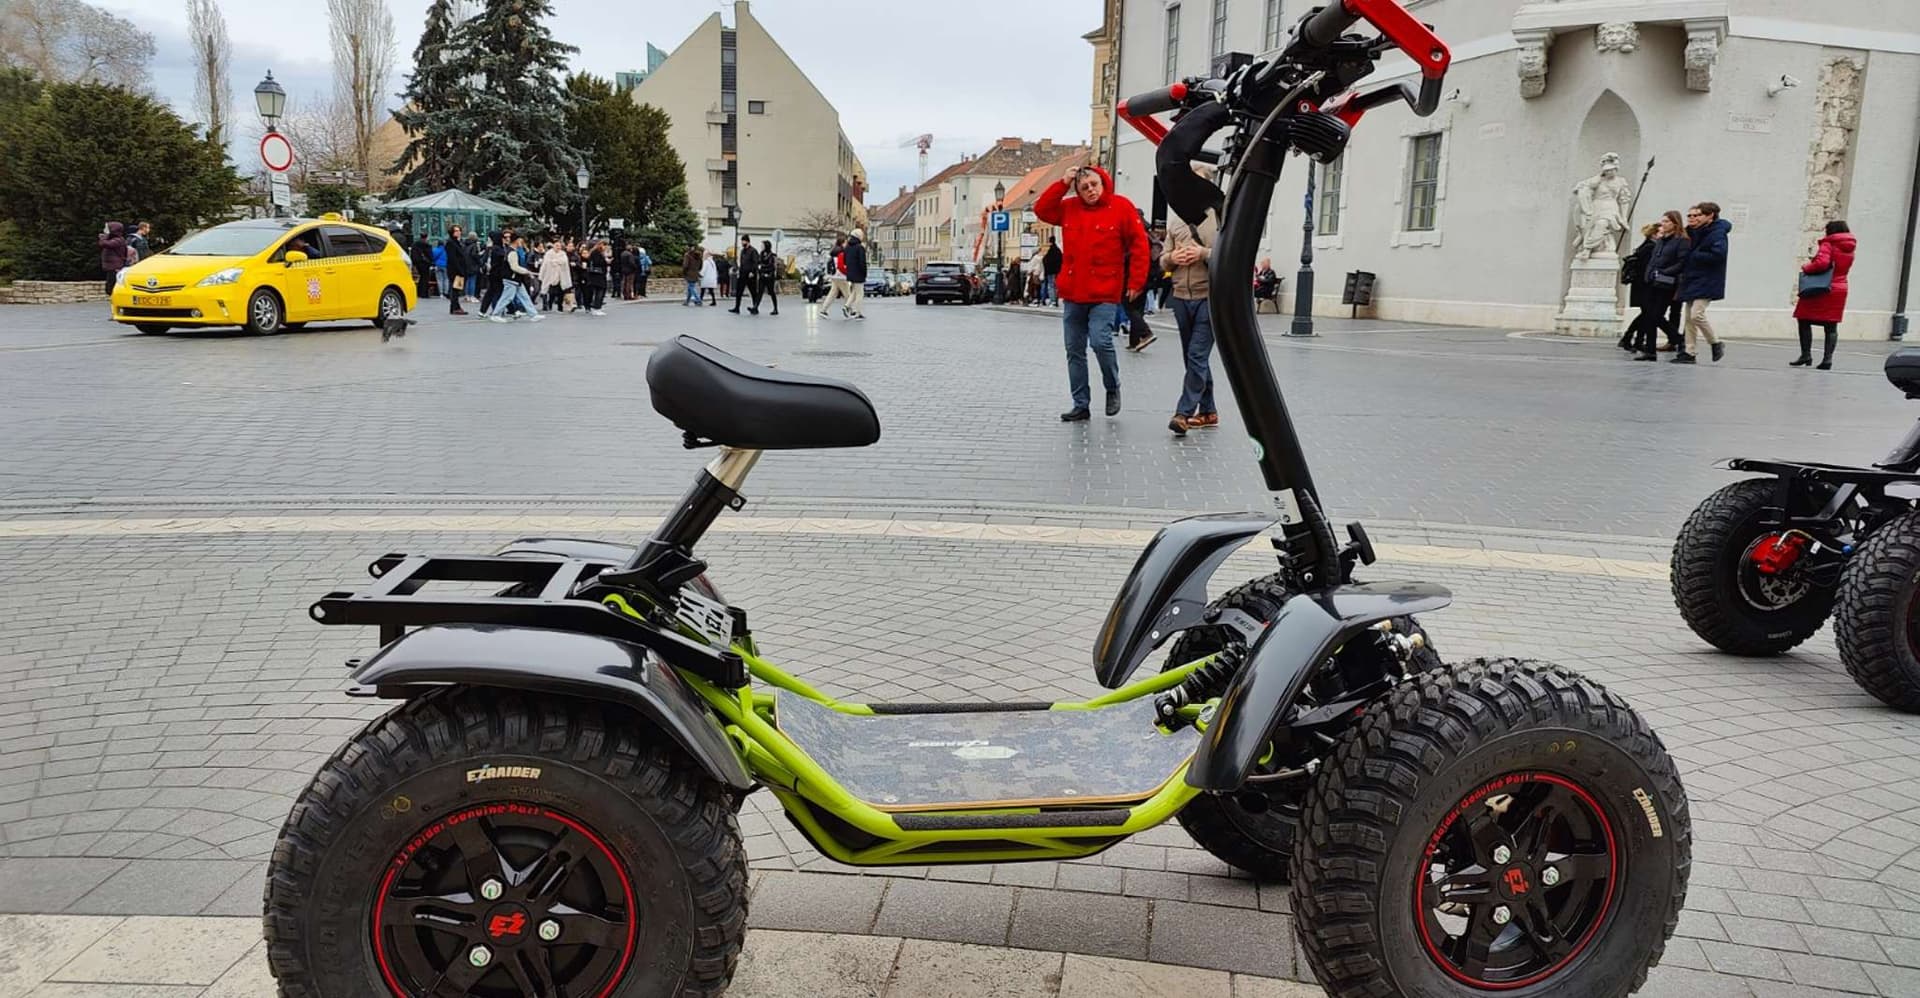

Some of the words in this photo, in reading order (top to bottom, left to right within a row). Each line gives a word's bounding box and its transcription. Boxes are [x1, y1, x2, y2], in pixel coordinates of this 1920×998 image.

[994, 213, 1006, 230] P
[466, 764, 541, 783] EZRAIDER
[1461, 780, 1504, 809] Genuine
[1505, 774, 1529, 785] Part
[448, 803, 506, 826] Genuine
[509, 802, 540, 816] Part
[1632, 787, 1663, 837] EZRAIDER
[1503, 868, 1529, 895] EZ
[489, 912, 525, 937] EZ
